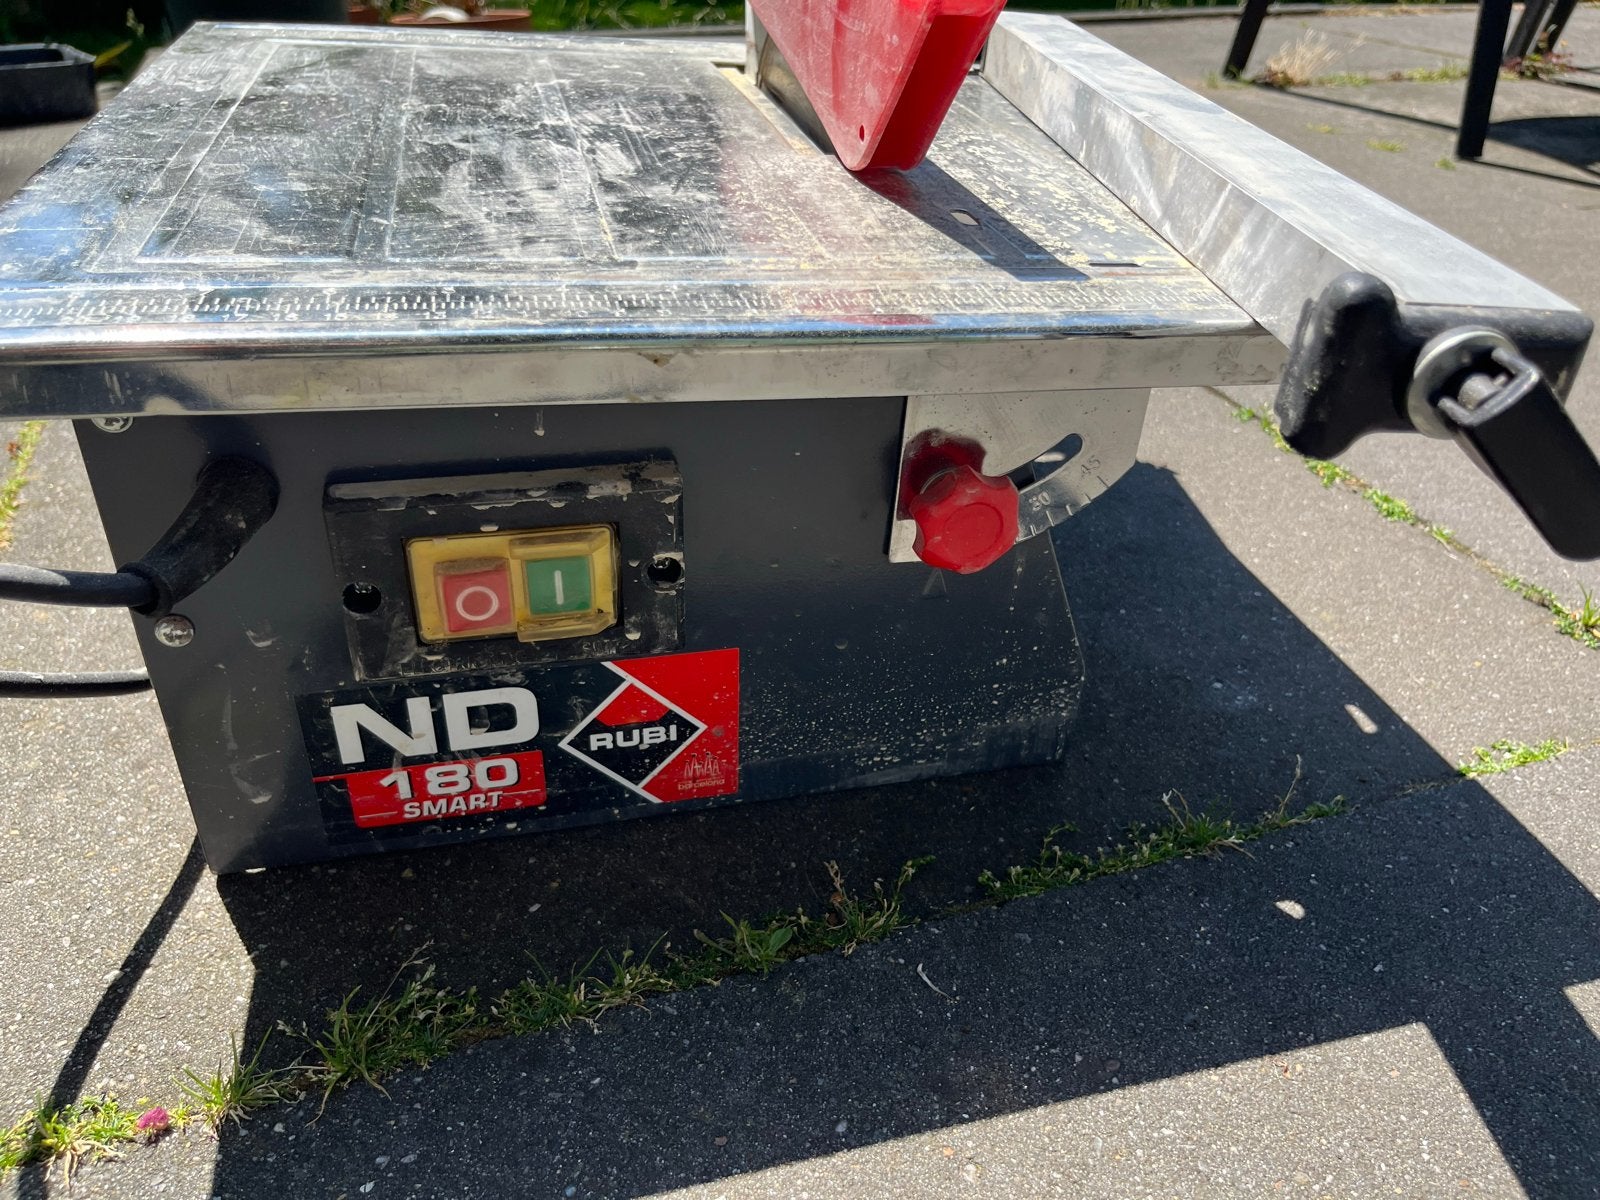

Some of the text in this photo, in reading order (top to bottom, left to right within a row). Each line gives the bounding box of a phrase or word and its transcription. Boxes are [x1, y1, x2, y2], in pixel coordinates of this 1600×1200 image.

[1028, 491, 1051, 512] 30
[329, 686, 540, 765] ND
[589, 724, 678, 752] RUBI
[379, 757, 519, 800] 180
[403, 790, 503, 819] SMART
